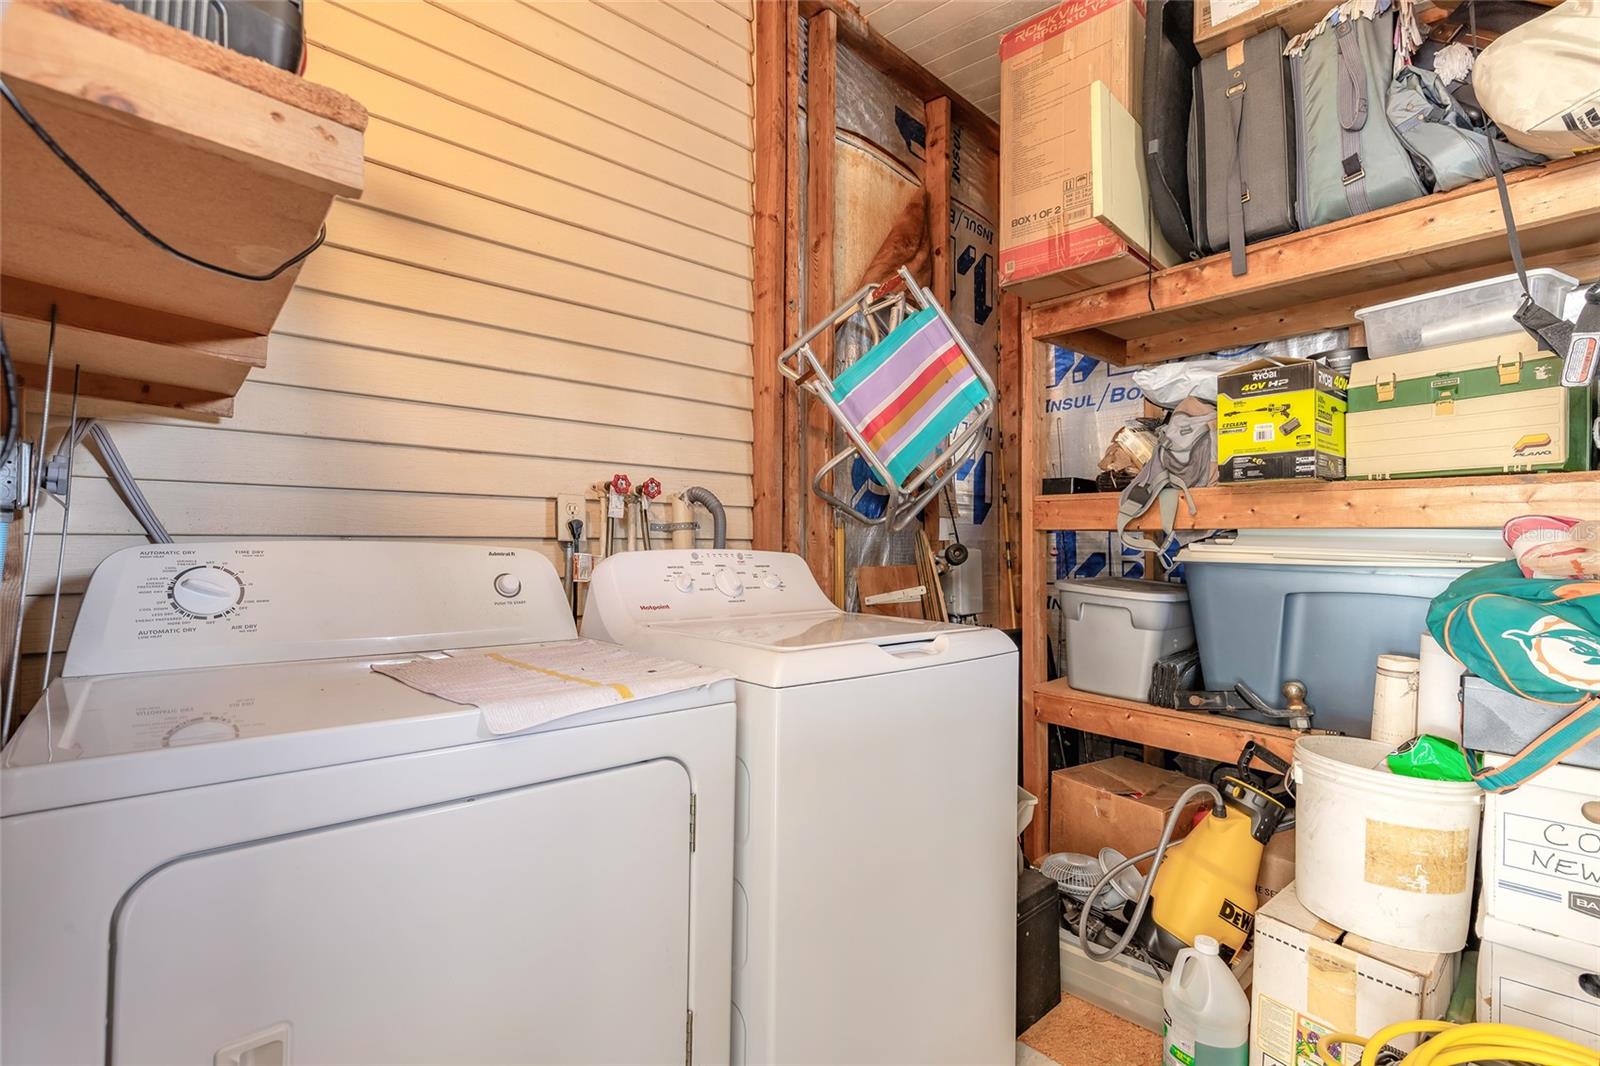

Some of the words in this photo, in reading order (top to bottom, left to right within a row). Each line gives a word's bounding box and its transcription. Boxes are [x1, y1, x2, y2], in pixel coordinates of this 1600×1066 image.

[1011, 214, 1031, 228] BOX
[1032, 213, 1038, 222] 1
[1039, 208, 1054, 220] OF
[1054, 205, 1062, 215] 2
[1251, 370, 1278, 381] RYOBI
[1241, 382, 1265, 392] 40V
[1267, 378, 1289, 388] HP
[1046, 382, 1145, 413] INSUL/BO
[138, 628, 181, 636] AUTOMATIC
[1219, 900, 1255, 932] DEW
